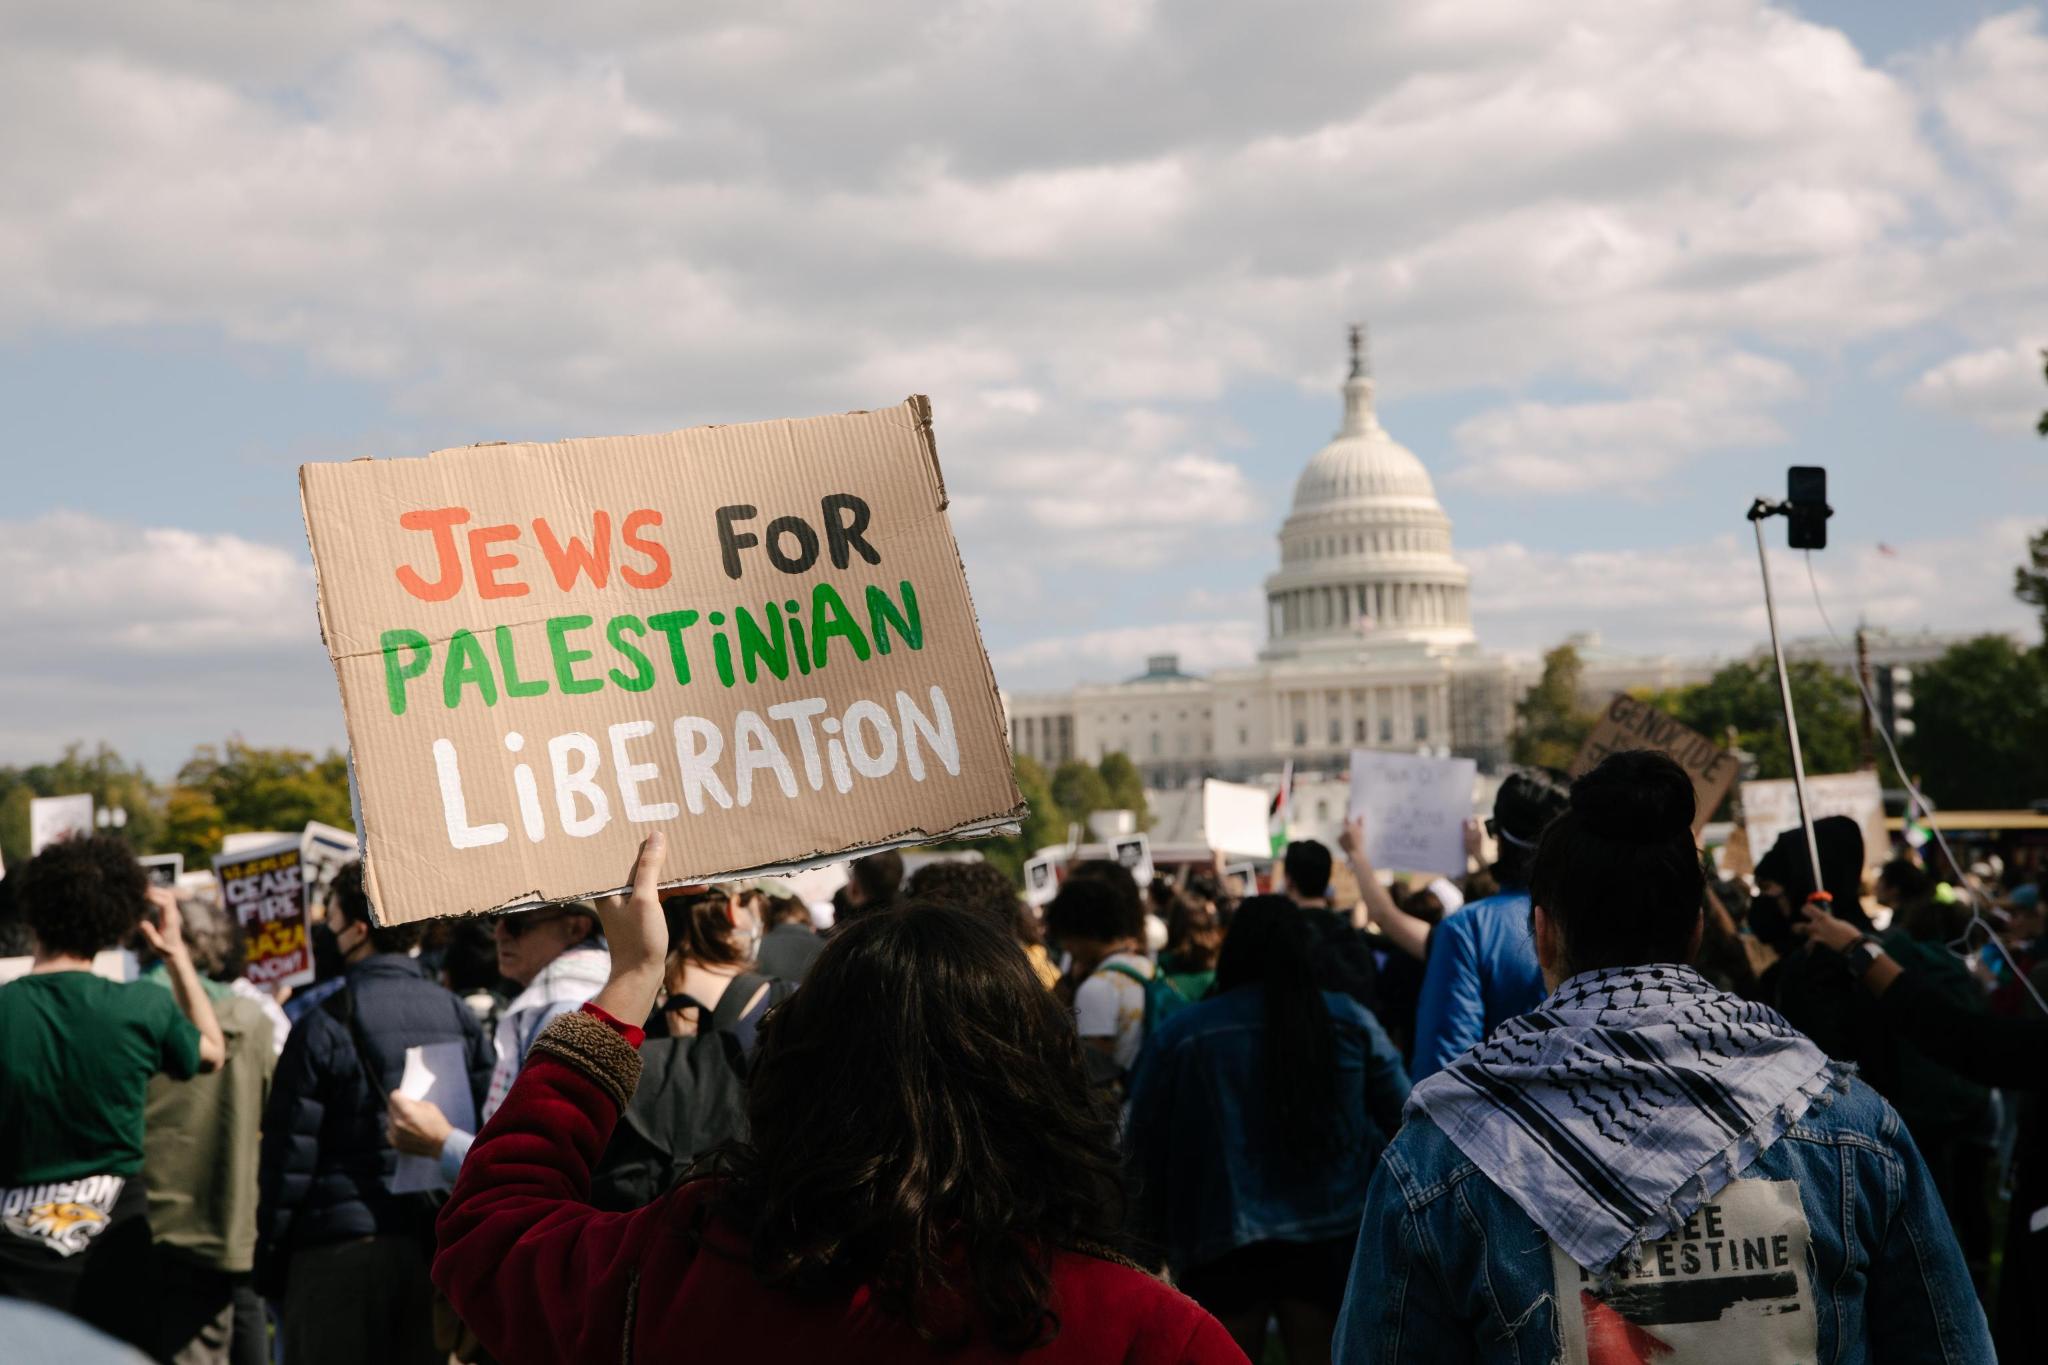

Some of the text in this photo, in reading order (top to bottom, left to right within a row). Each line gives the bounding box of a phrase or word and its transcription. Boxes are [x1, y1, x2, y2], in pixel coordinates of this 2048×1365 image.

[396, 494, 883, 602] JEWS FOR
[1608, 692, 1731, 783] GENOCIDE
[225, 866, 303, 903] CEASE
[237, 891, 300, 926] FIRE
[0, 1174, 125, 1217] OWSON
[1661, 1206, 1725, 1242] EE
[1580, 1235, 1789, 1282] ESTINE
